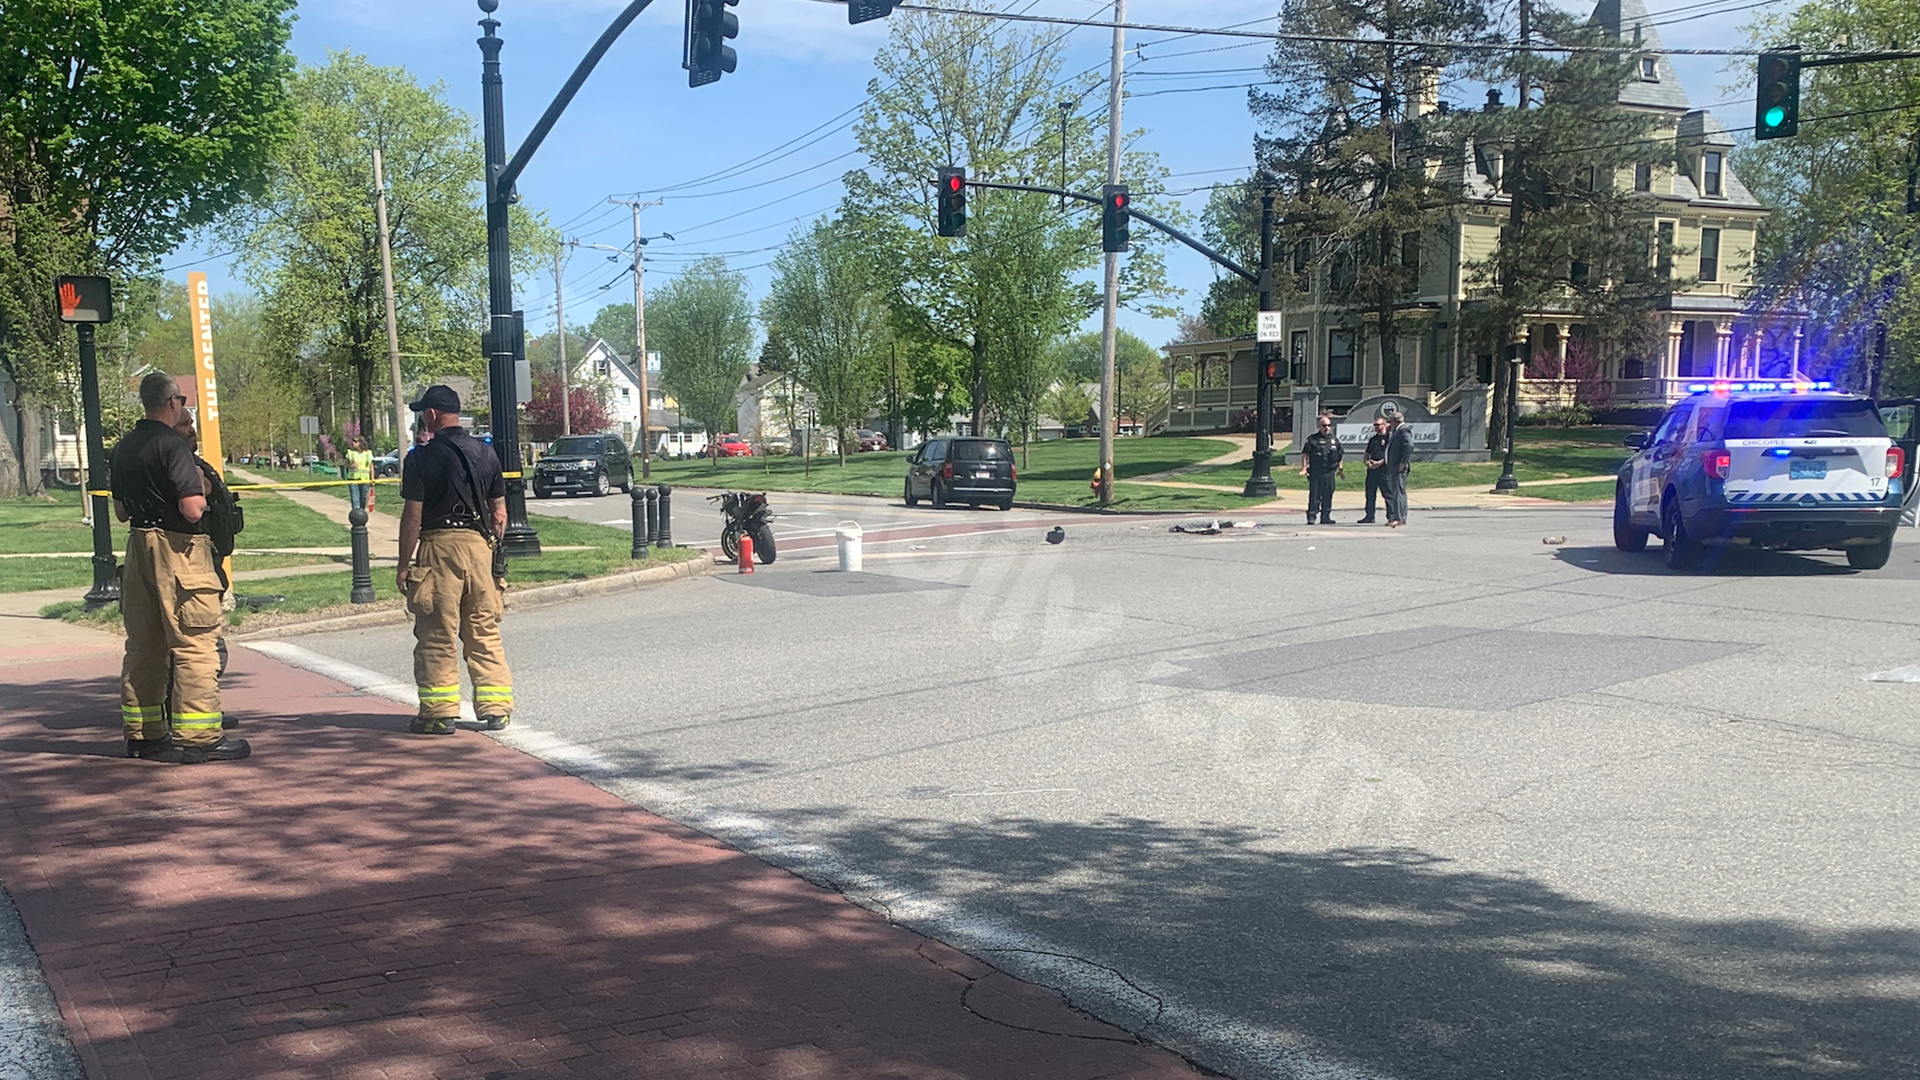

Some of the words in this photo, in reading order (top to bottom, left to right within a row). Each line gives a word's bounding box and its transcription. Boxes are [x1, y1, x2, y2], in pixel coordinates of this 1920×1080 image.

[205, 377, 219, 421] THE
[1339, 433, 1357, 441] OUR
[1414, 432, 1436, 440] ELMS
[1870, 477, 1881, 487] 17
